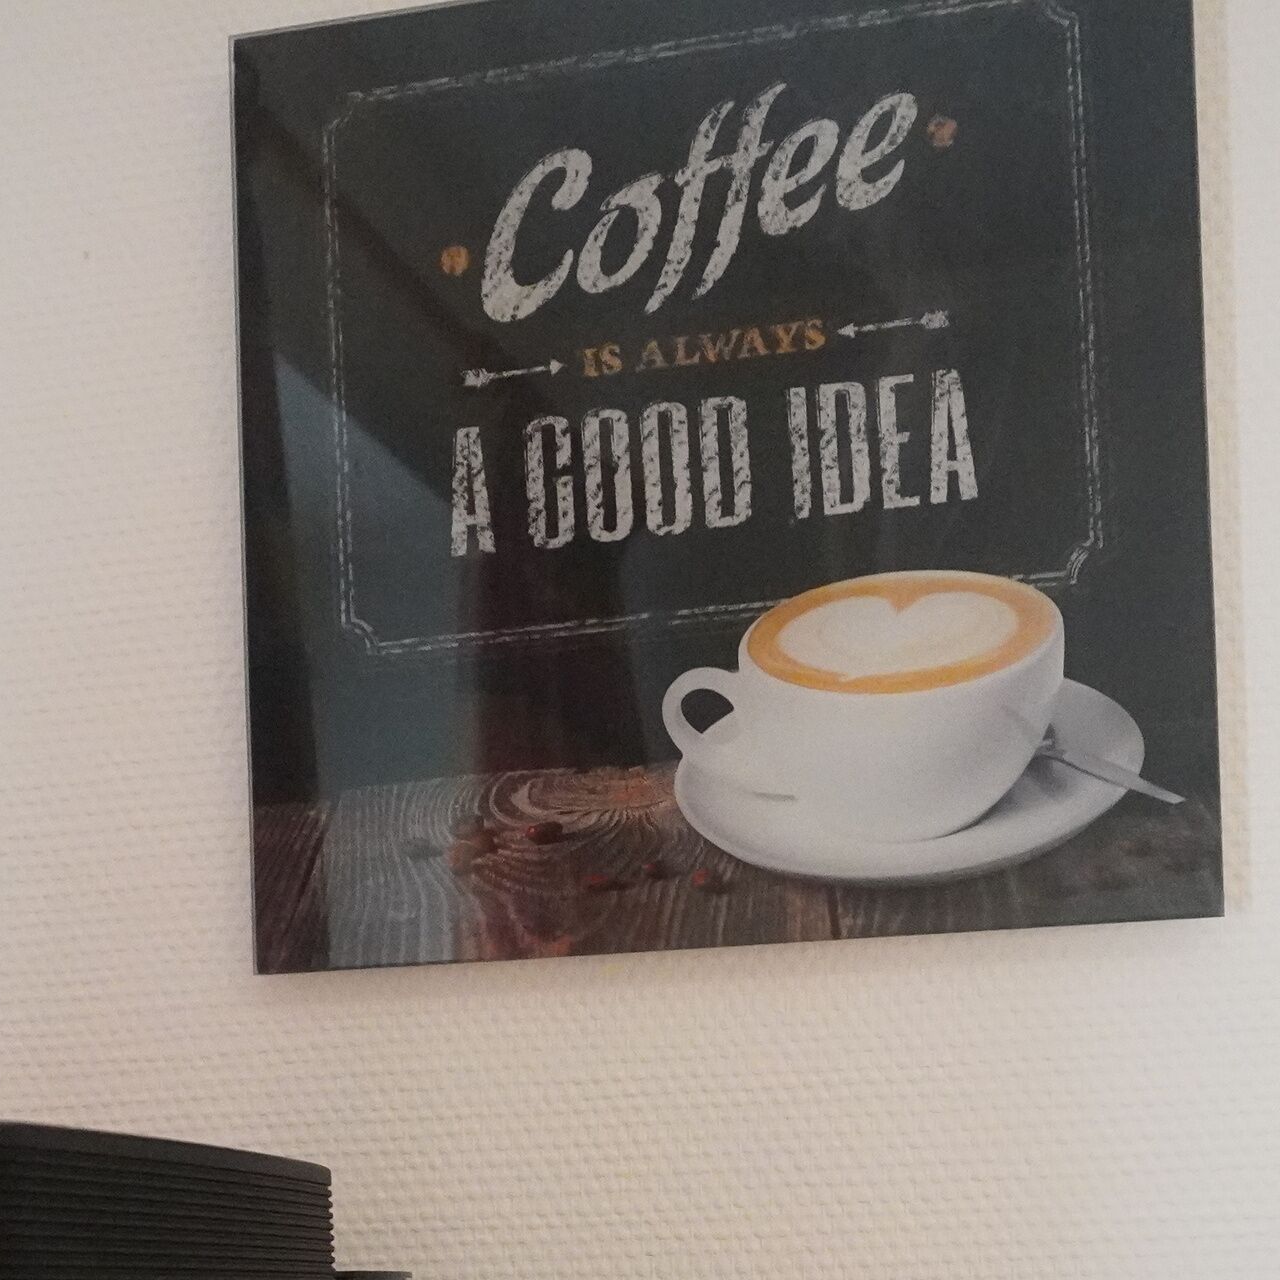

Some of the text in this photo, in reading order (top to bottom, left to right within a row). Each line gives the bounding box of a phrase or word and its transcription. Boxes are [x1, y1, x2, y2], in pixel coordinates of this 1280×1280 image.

[482, 81, 919, 322] Coffee
[581, 318, 829, 378] IS ALWAYS
[450, 367, 979, 557] A GOOD IDEA
